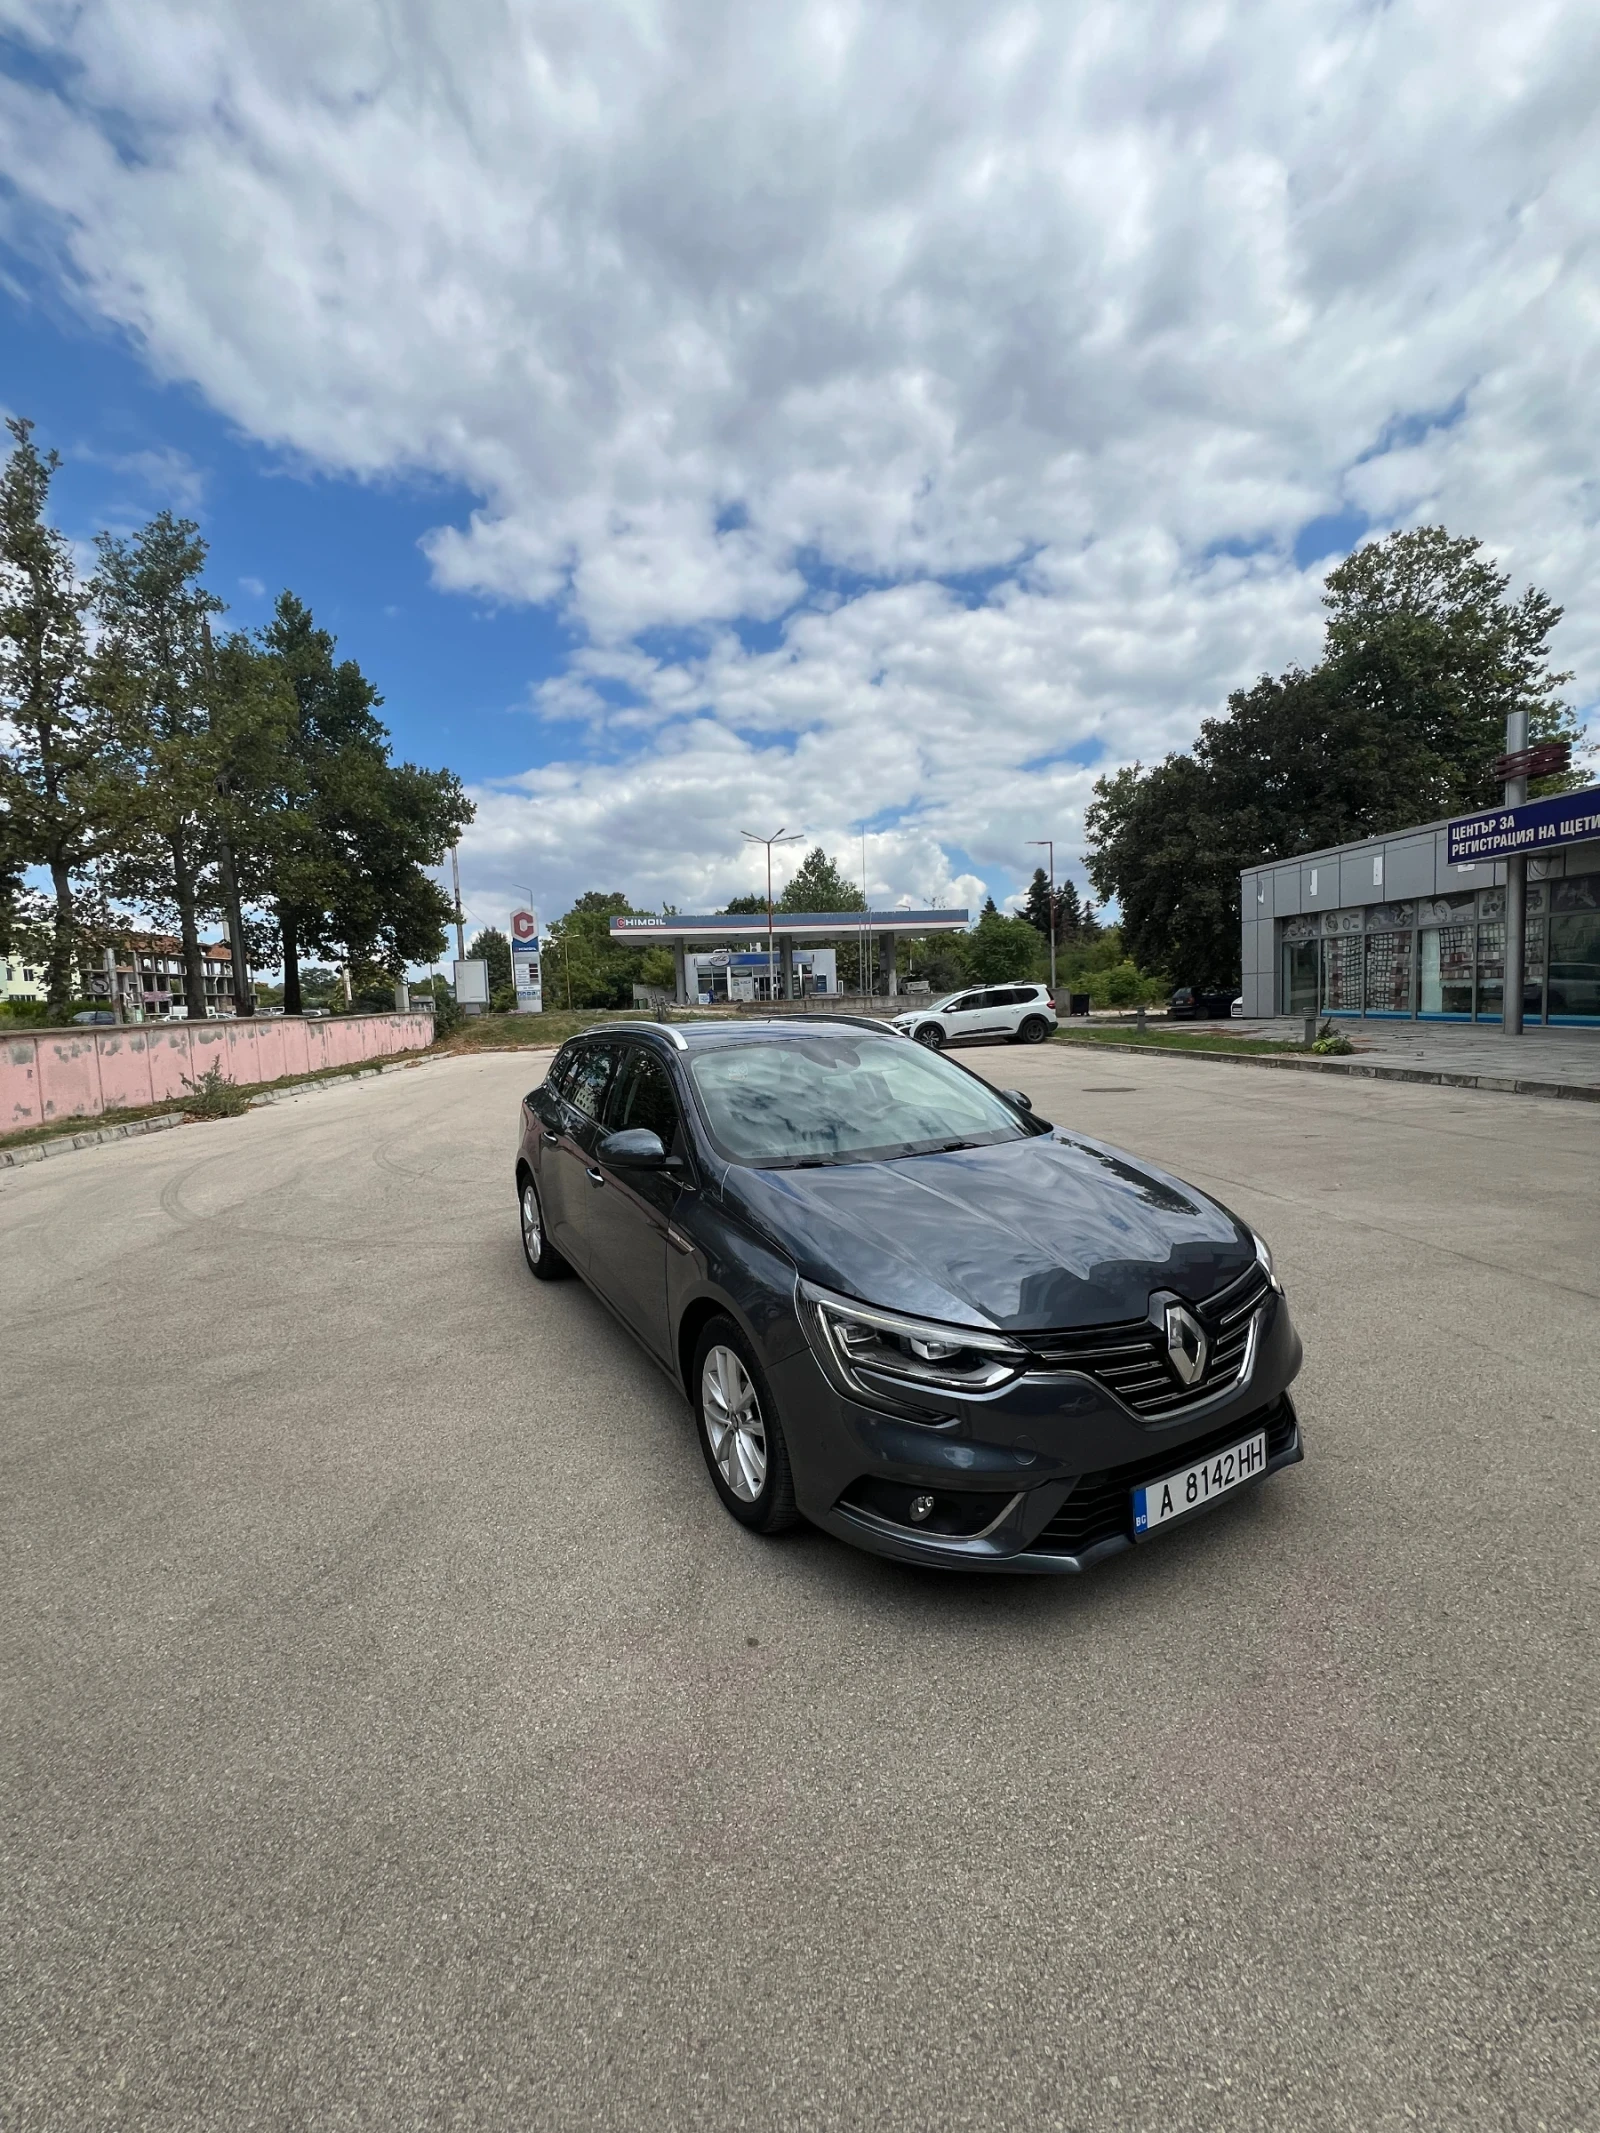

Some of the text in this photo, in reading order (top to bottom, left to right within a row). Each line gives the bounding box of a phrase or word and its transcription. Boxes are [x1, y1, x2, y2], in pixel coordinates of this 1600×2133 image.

[1452, 815, 1515, 841] ЦЕНТЪР ЗА
[1452, 814, 1600, 857] РЕГИСТРАЦИЯ НА ЩЕТИ
[1161, 1484, 1173, 1517] A
[1136, 1515, 1146, 1526] BG
